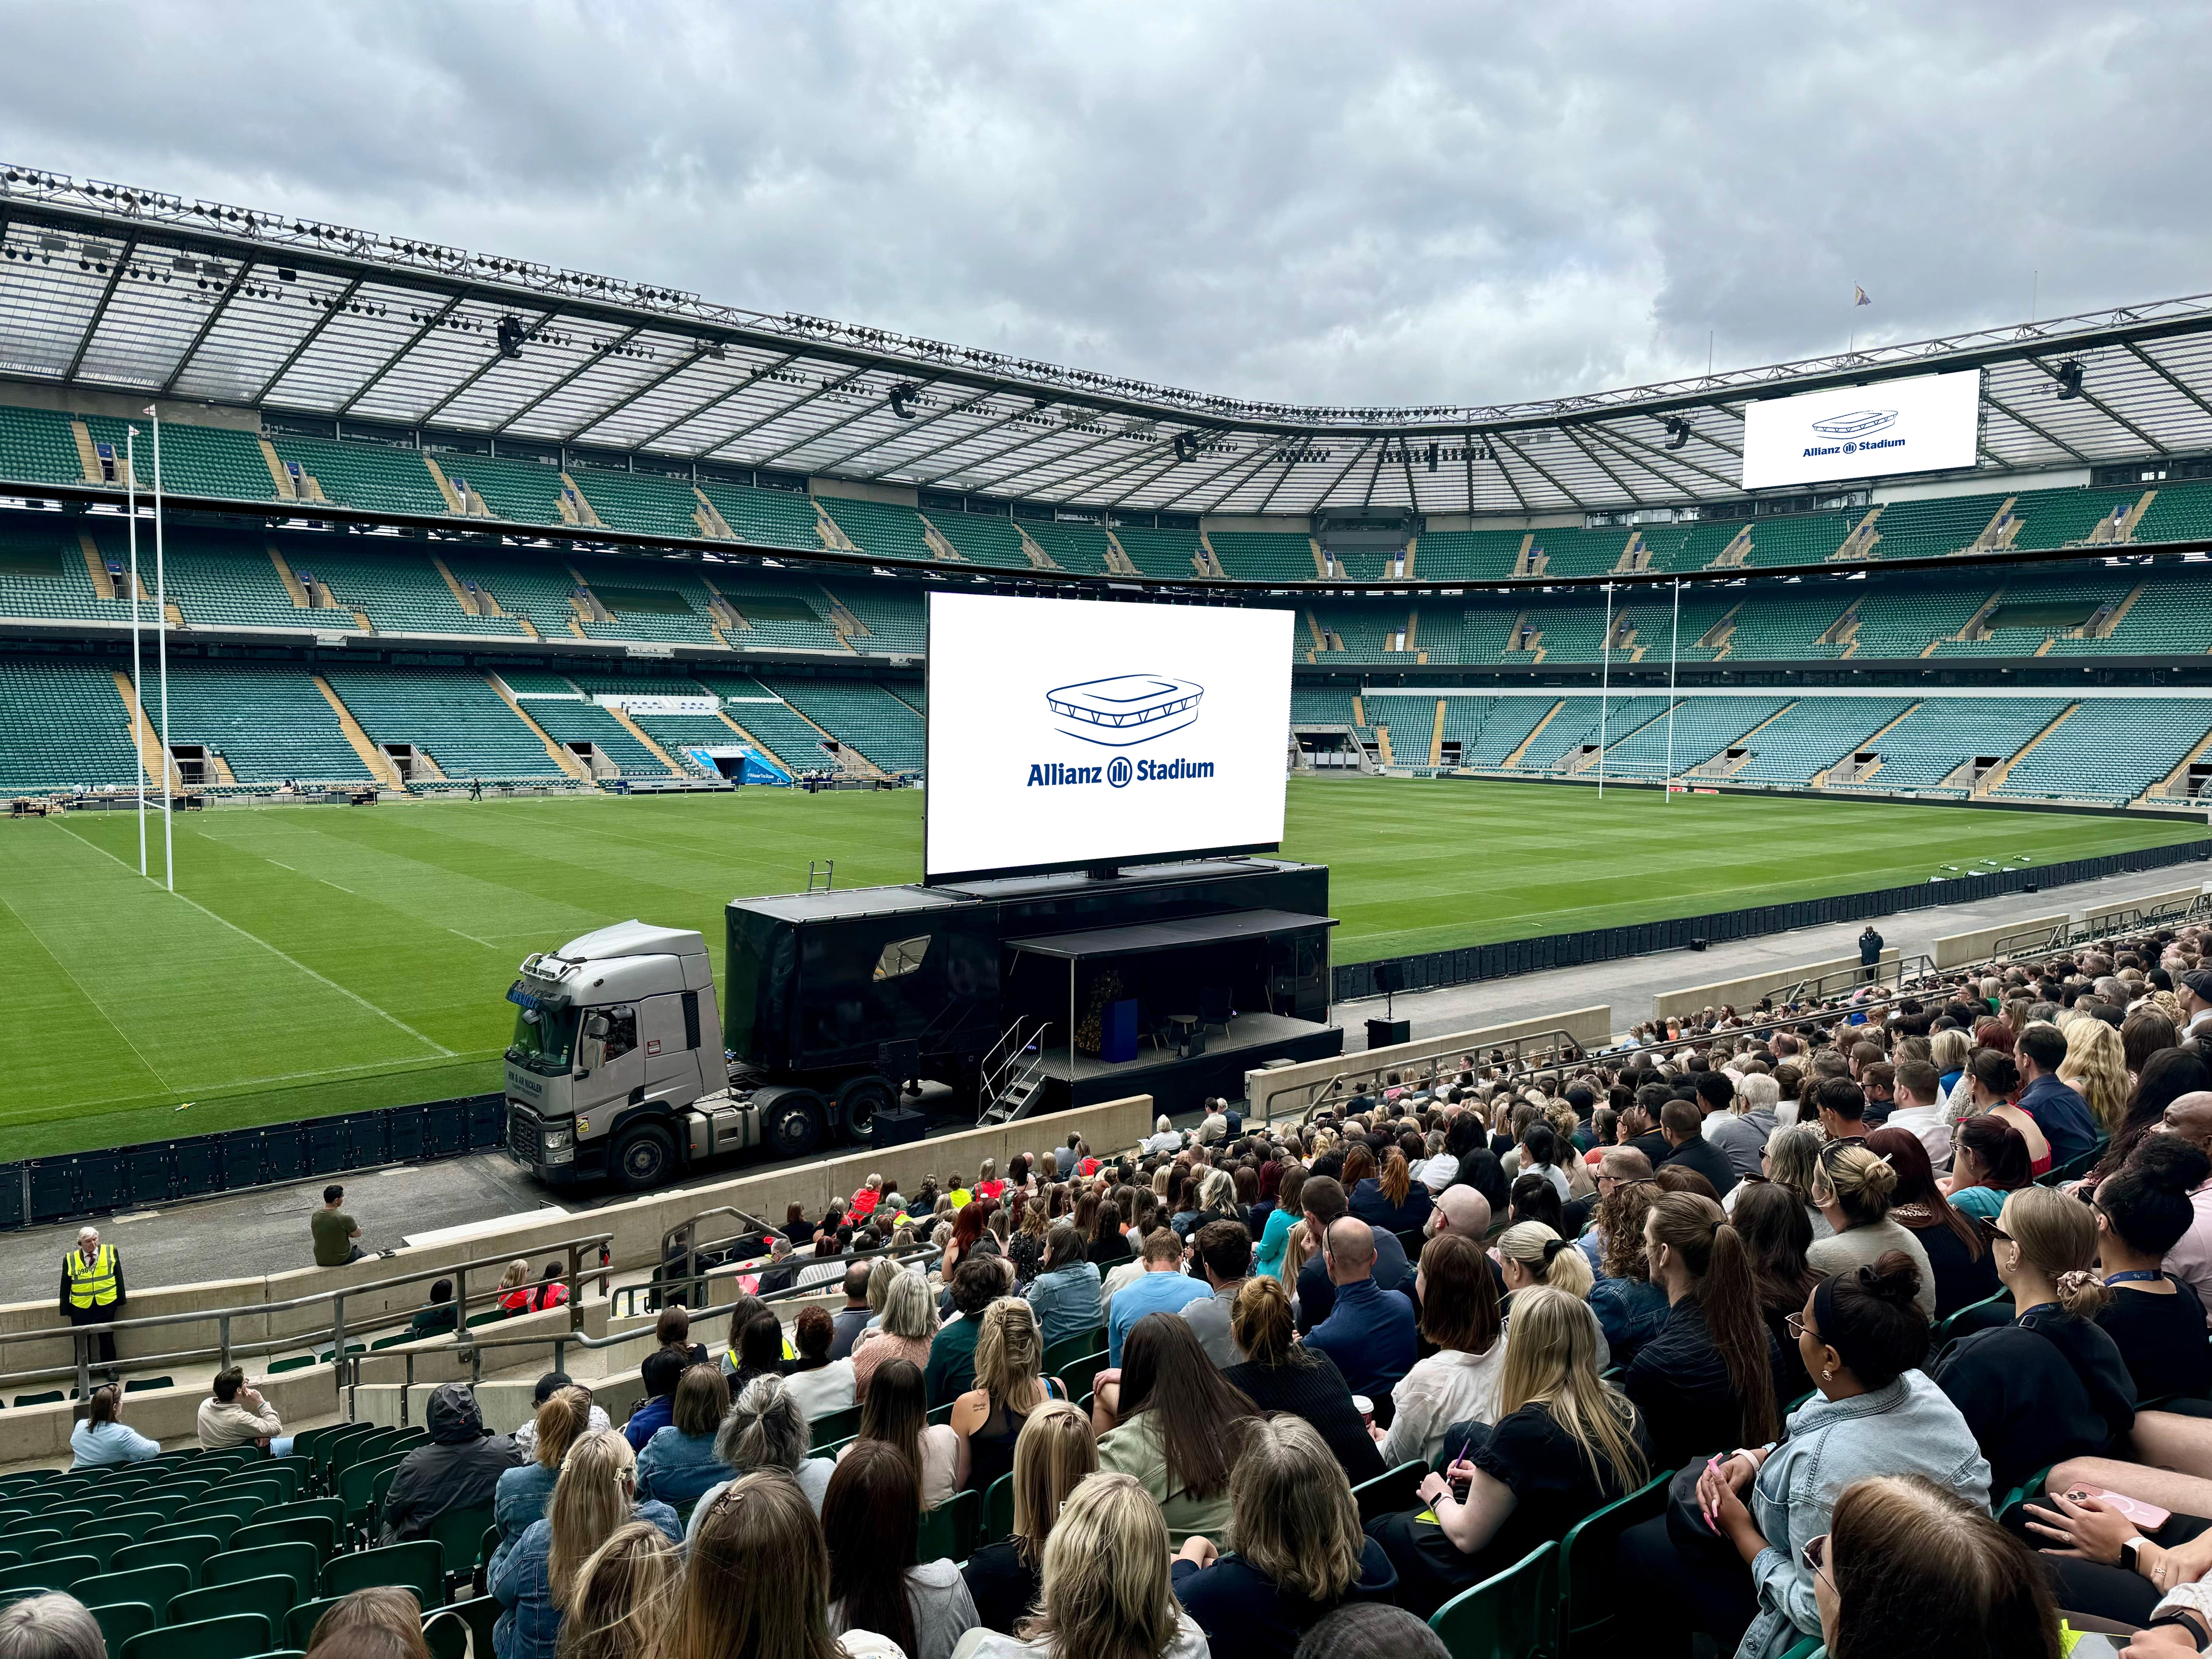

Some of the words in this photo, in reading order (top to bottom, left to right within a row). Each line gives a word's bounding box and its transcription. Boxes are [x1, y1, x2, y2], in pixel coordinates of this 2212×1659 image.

[1803, 445, 1840, 457] Allianz
[1859, 438, 1906, 450] Stadium
[1027, 763, 1102, 787] Allianz
[1137, 757, 1214, 781] Stadium
[512, 991, 536, 1007] RENAULT
